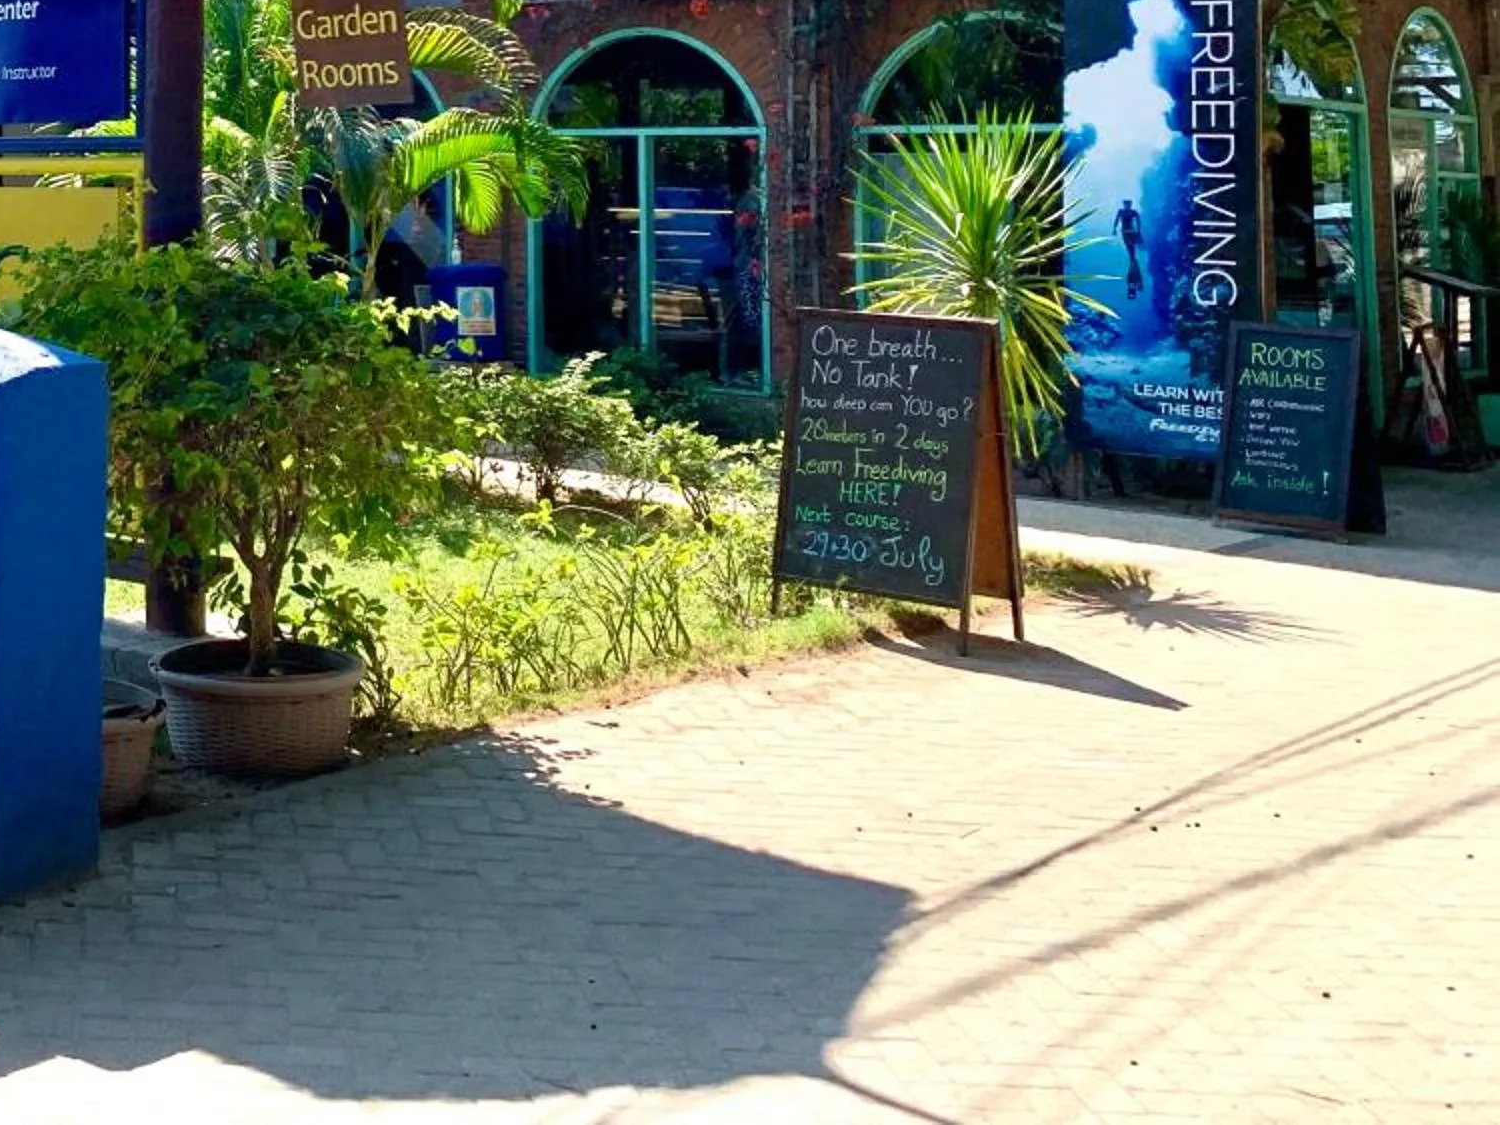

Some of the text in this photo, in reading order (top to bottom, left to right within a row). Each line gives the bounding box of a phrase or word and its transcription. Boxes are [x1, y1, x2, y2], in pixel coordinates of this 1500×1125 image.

[297, 3, 398, 40] Garden
[2, 65, 58, 81] Instructor
[302, 59, 399, 90] Rooms
[1190, 0, 1238, 308] FREEDIVING
[812, 325, 858, 356] One
[812, 359, 842, 385] No
[1239, 367, 1327, 392] AVAILABLE
[801, 386, 828, 410] how
[833, 393, 867, 413] deep
[900, 393, 933, 417] YOU
[1133, 382, 1225, 404] LEARN WIT
[1158, 402, 1192, 418] THE
[871, 428, 886, 446] in
[893, 423, 910, 451] 2
[913, 431, 950, 459] days
[795, 444, 948, 502] Learn Freediving
[839, 480, 902, 507] HERE!
[795, 503, 832, 523] Next
[879, 535, 946, 586] July
